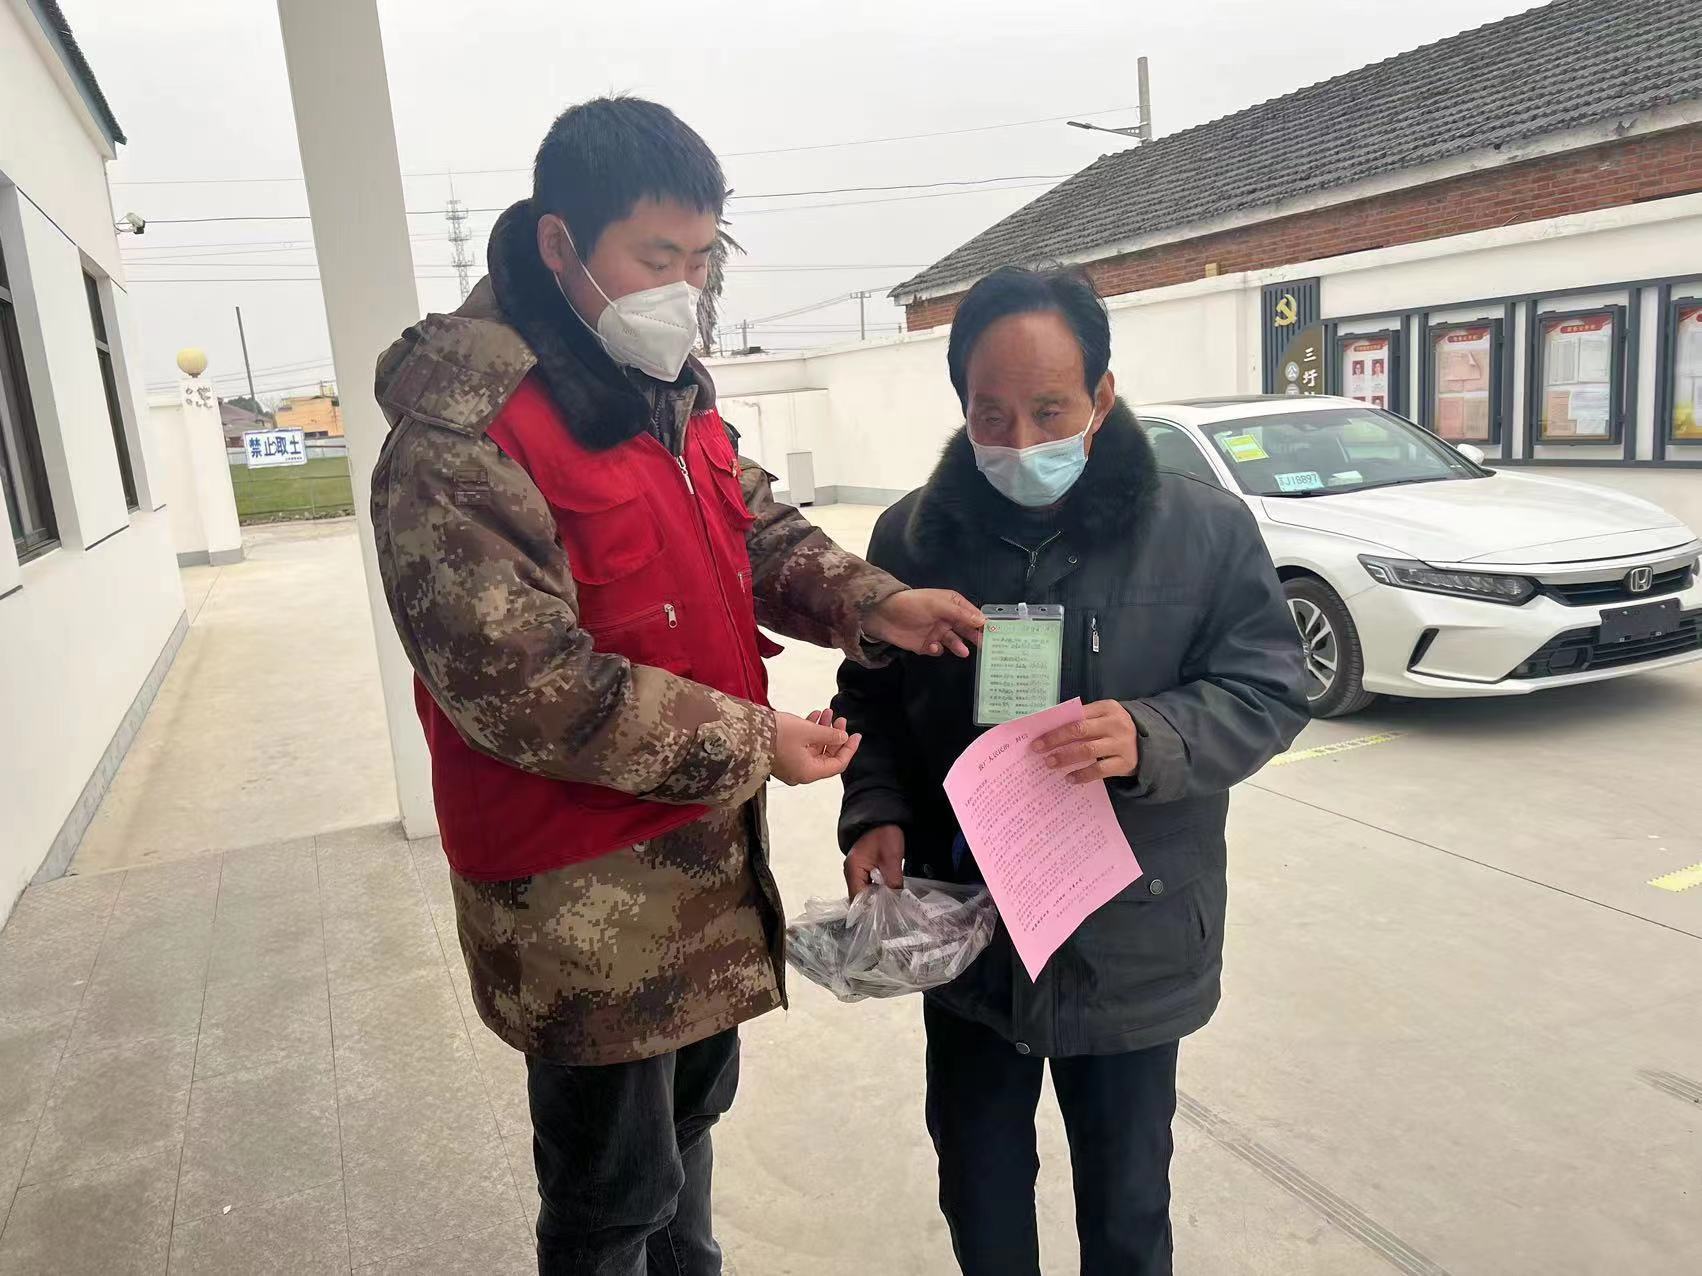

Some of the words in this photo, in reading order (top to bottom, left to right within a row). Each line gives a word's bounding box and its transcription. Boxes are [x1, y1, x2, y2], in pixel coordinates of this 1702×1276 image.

[1303, 347, 1318, 395] 三圩
[249, 435, 302, 458] 禁止取土
